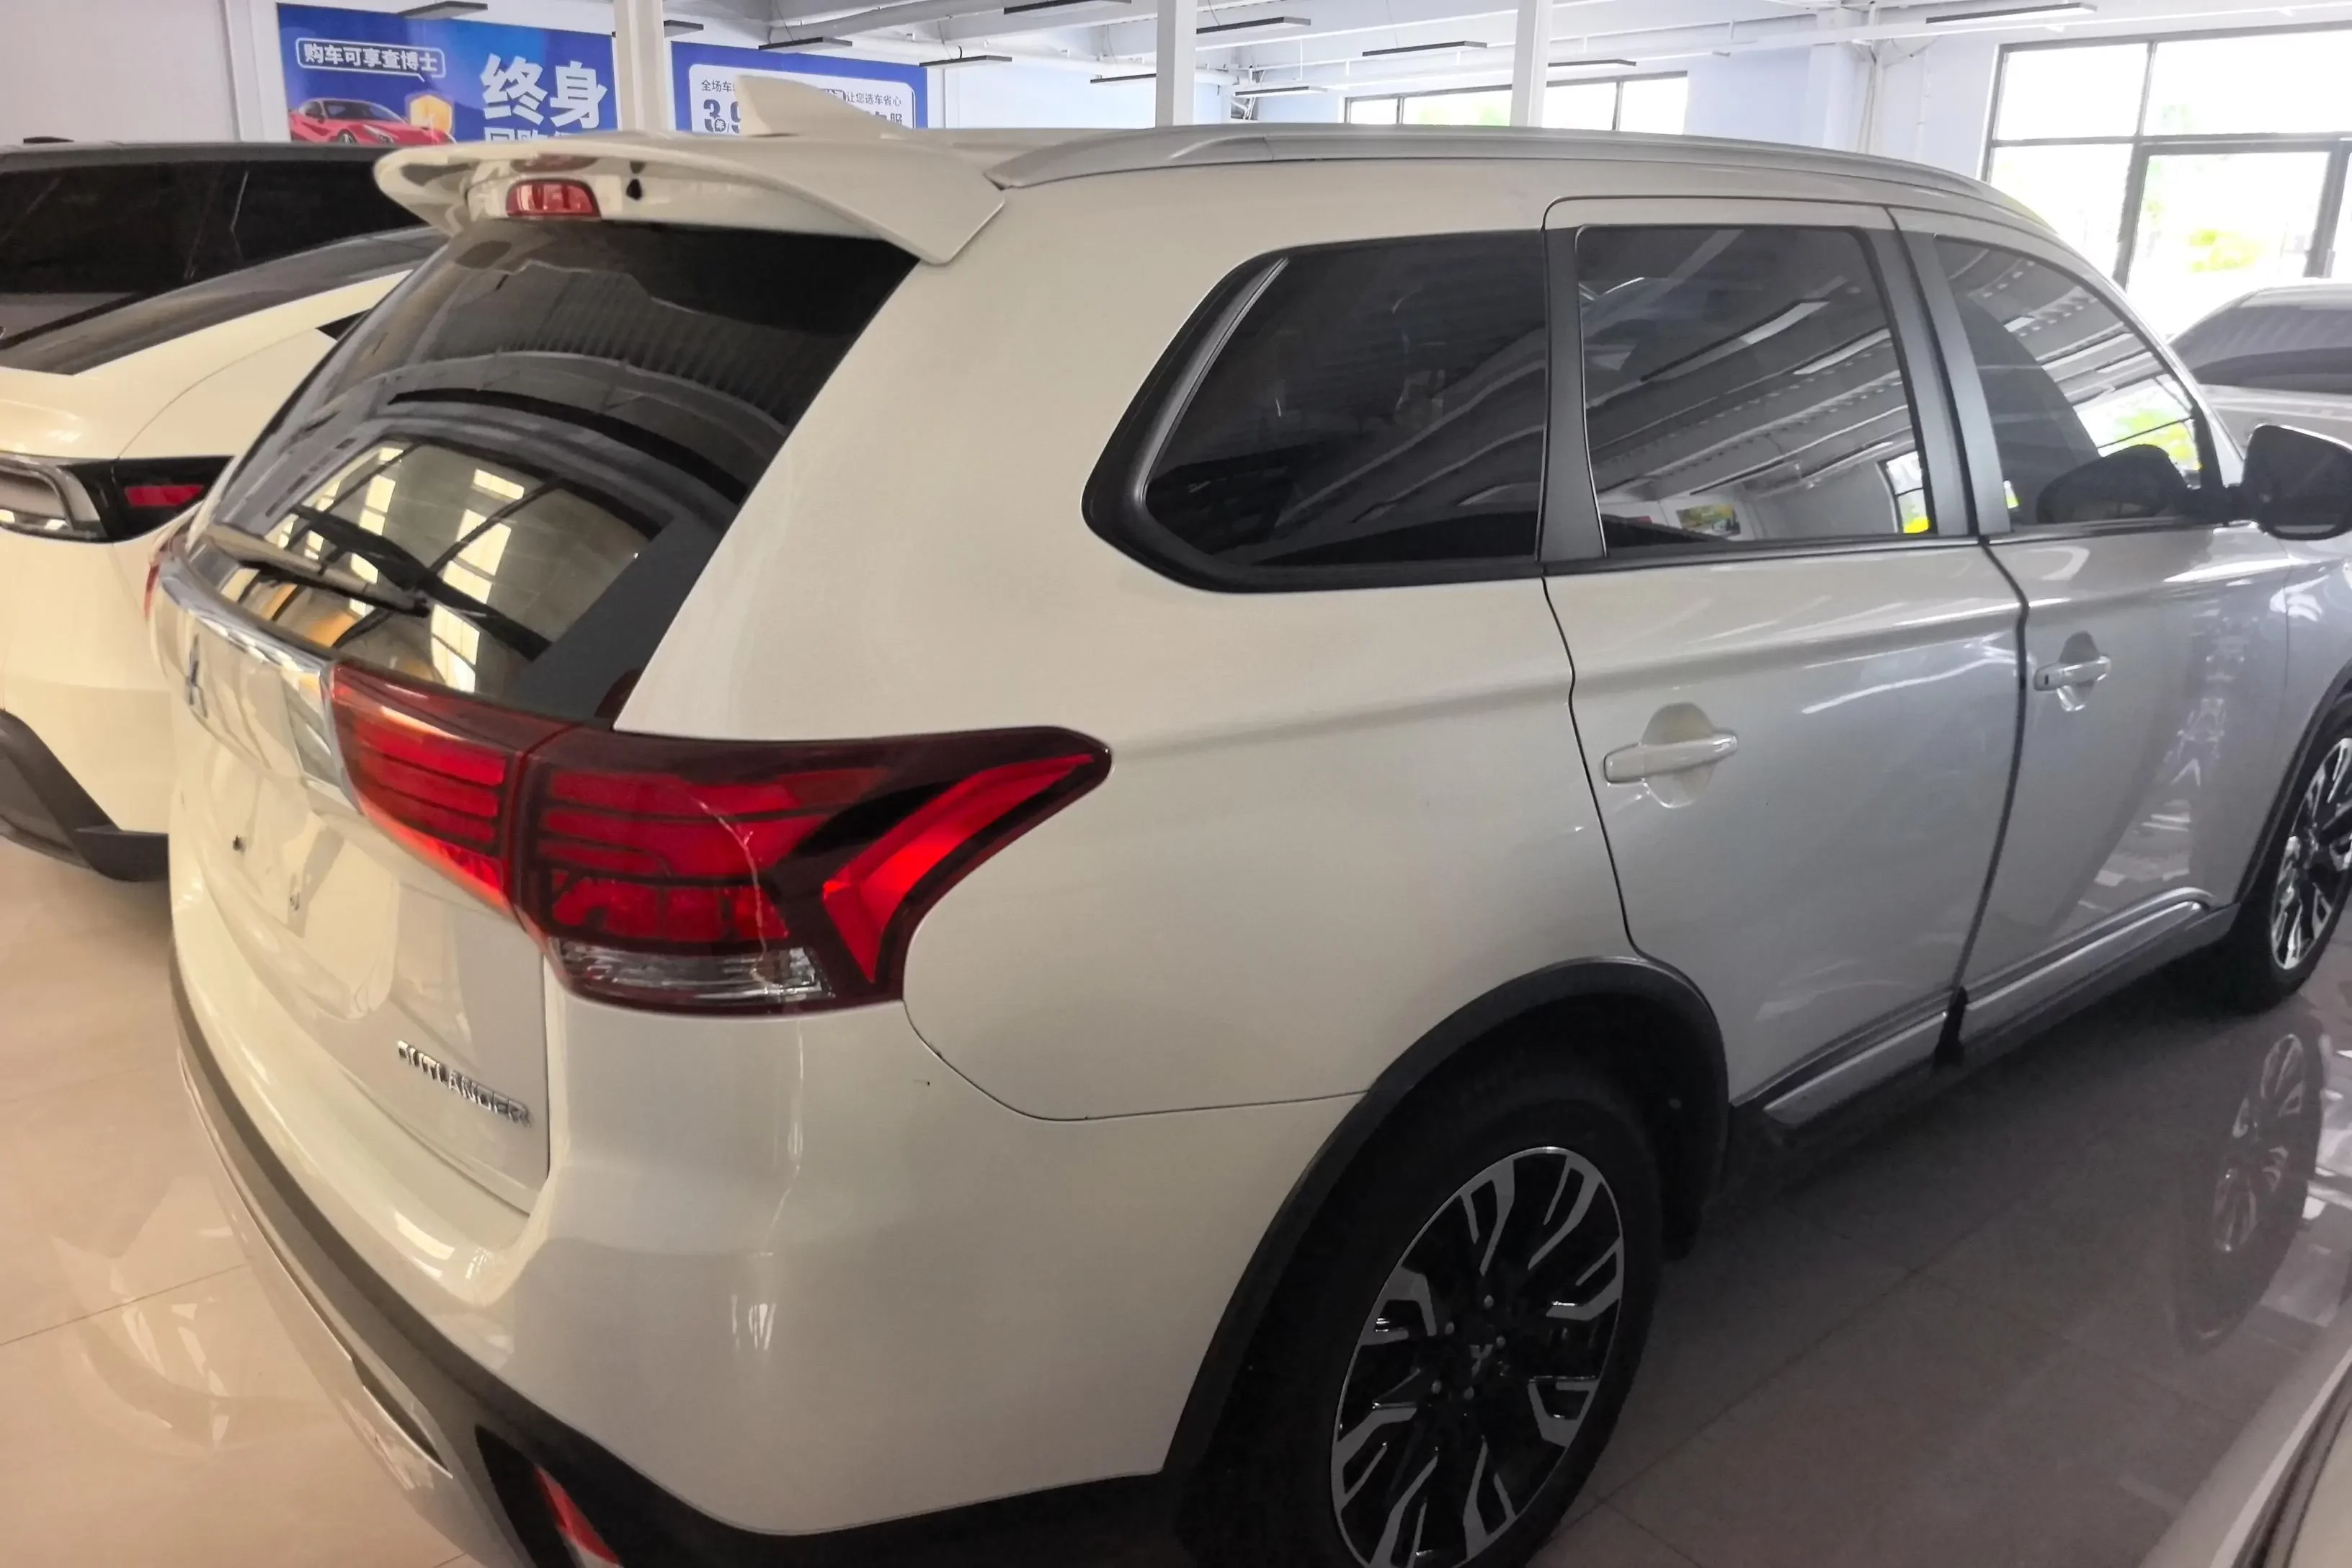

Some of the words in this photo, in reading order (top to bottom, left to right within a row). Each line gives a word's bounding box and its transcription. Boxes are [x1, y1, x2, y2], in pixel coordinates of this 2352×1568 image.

[303, 43, 437, 71] 购车可享查博士
[480, 53, 607, 128] 终身
[701, 79, 735, 92] 全场车
